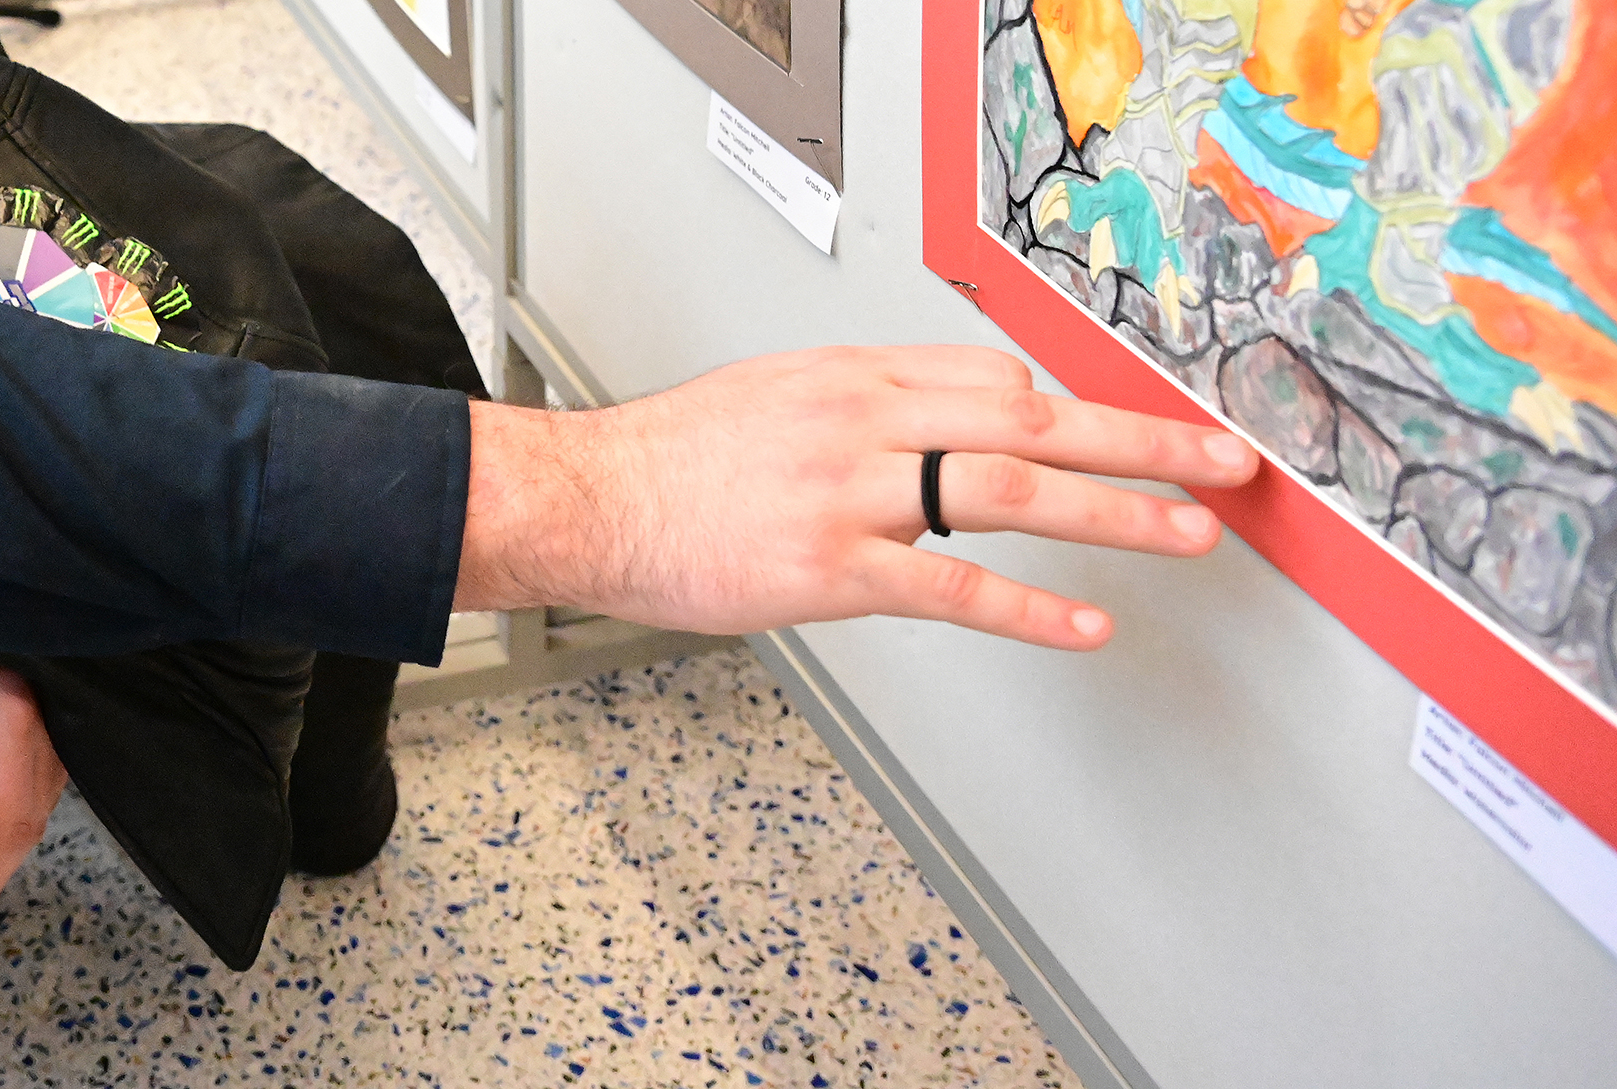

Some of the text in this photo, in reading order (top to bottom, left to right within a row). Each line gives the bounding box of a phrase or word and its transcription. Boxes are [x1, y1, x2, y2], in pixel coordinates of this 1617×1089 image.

[750, 131, 770, 152] Mitchell
[752, 167, 764, 184] Black
[765, 179, 787, 204] Charcoal
[804, 175, 831, 202] Grade: 12
